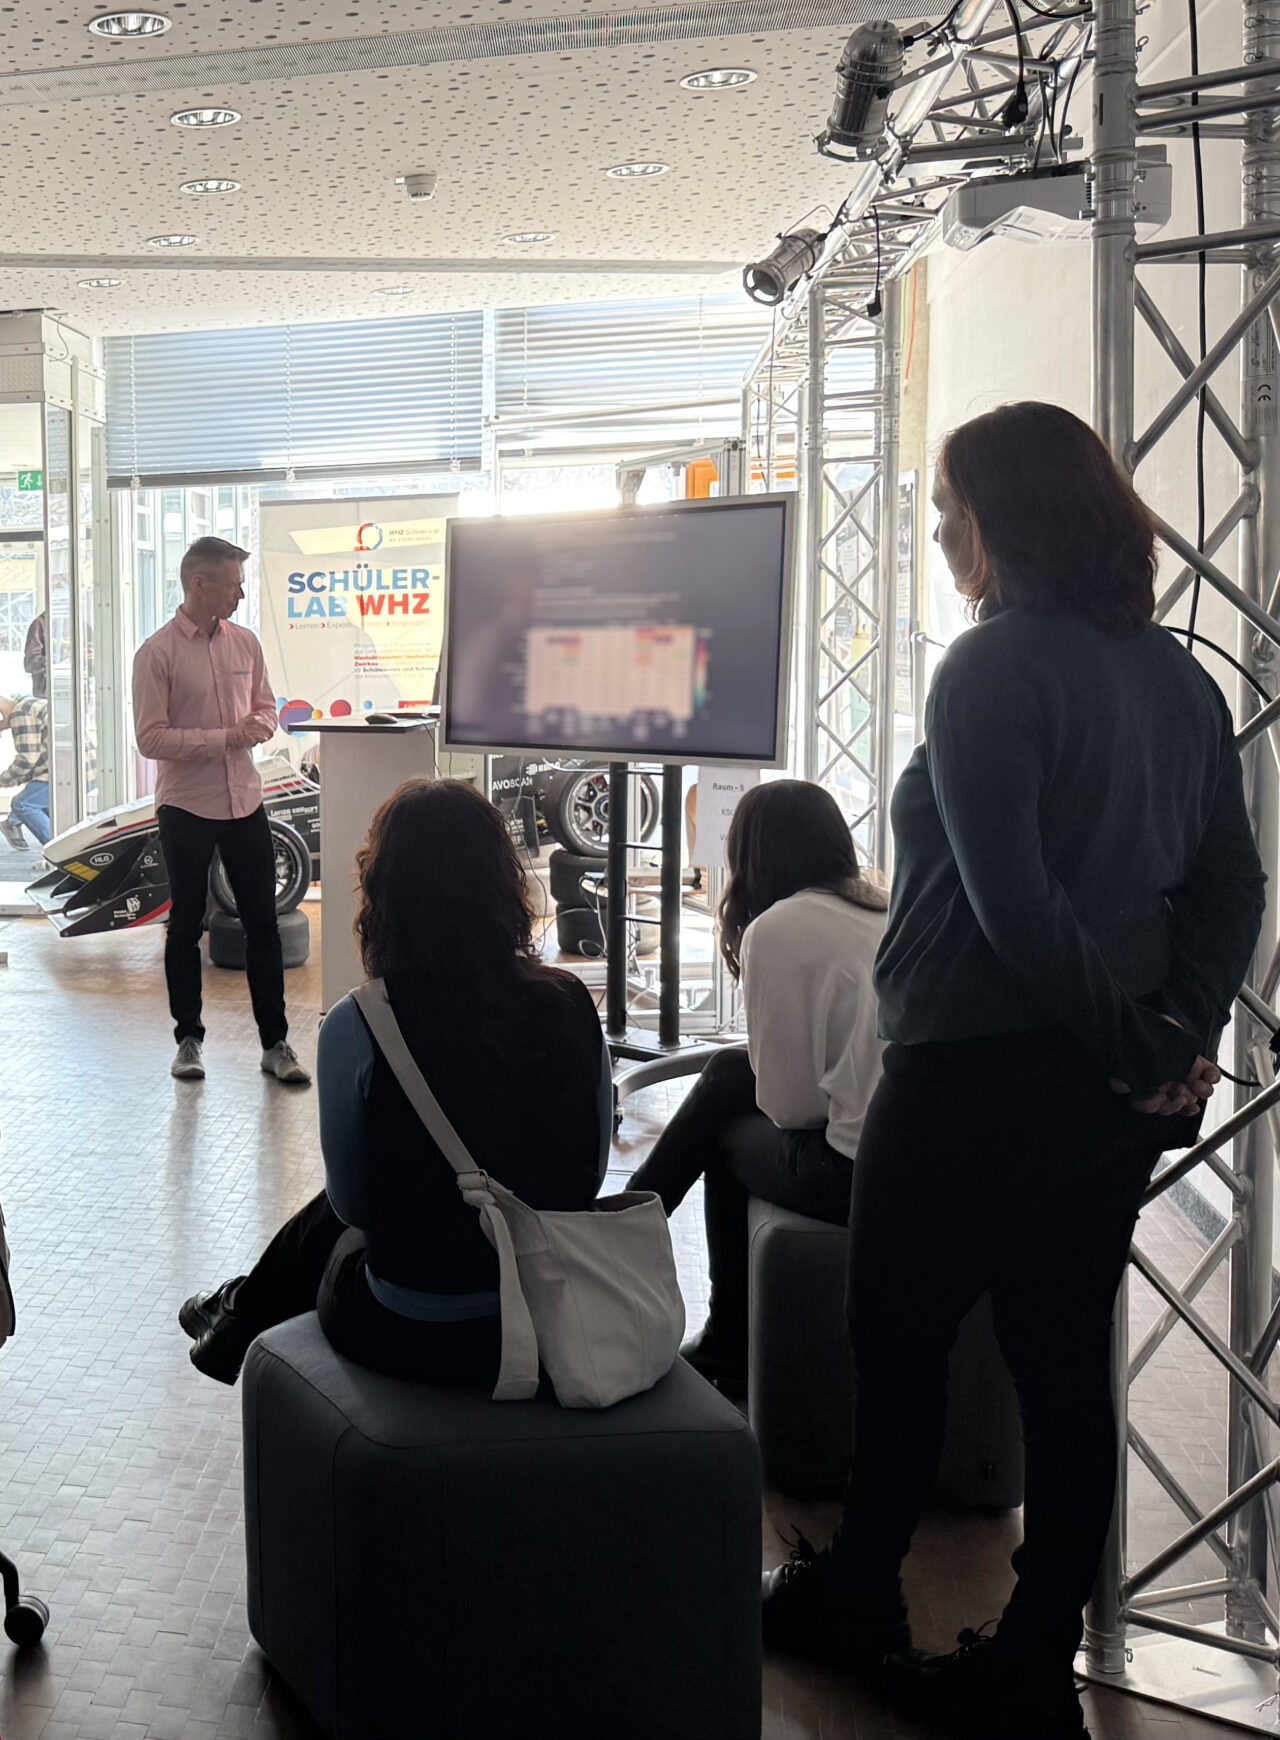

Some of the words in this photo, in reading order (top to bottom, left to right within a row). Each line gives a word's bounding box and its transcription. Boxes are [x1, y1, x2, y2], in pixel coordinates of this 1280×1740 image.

[287, 563, 440, 593] SCHÜLER-
[287, 595, 347, 619] LAB
[355, 593, 430, 616] WHZ
